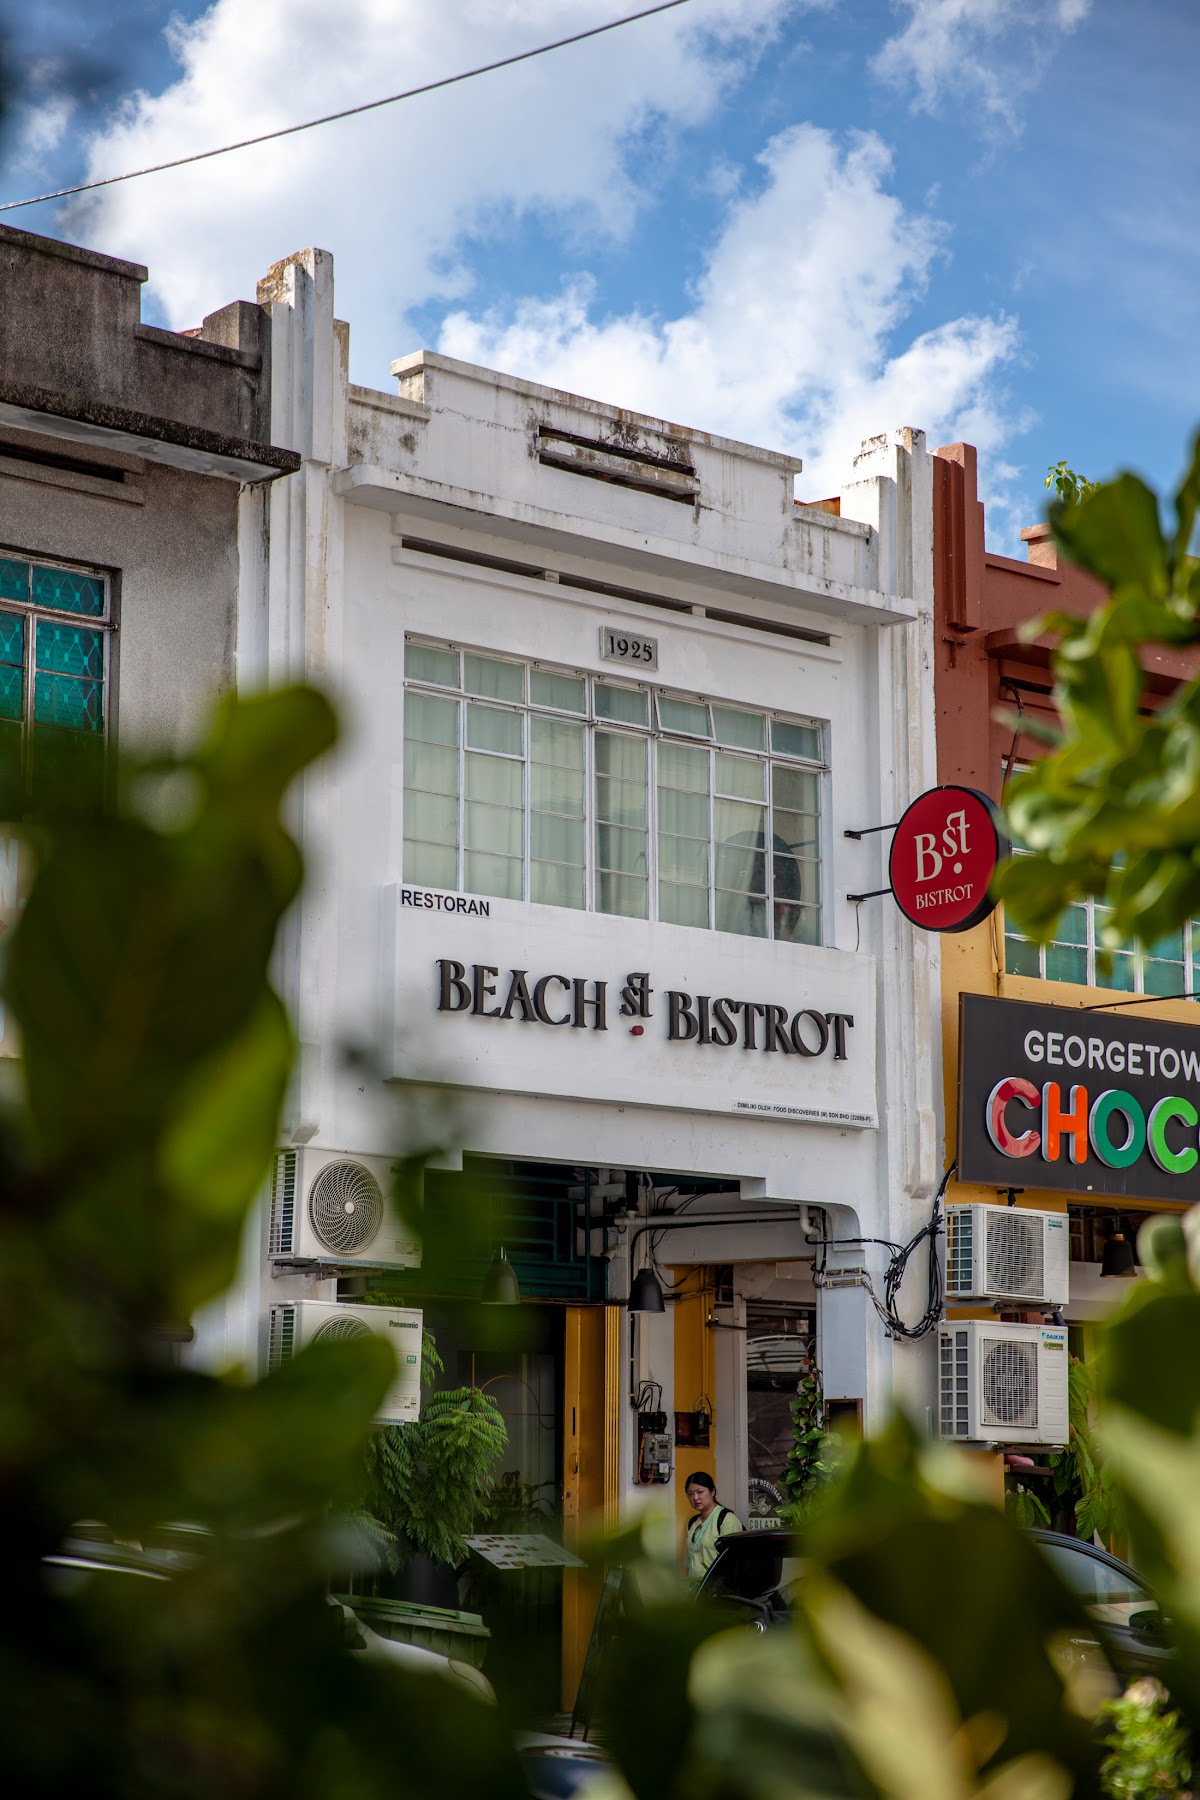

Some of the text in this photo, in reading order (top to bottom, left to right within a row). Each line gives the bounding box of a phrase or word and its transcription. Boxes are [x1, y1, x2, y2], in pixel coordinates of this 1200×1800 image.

[610, 636, 652, 661] 1925
[401, 890, 489, 916] RESTORAN
[916, 884, 973, 909] BISTROT
[436, 959, 608, 1031] BEACH
[664, 991, 854, 1060] BISTROT
[1024, 1030, 1200, 1082] GEORGETOW
[787, 1108, 819, 1117] DISCOVERIES
[986, 1077, 1200, 1174] CHOC
[389, 1320, 418, 1328] Panasonic
